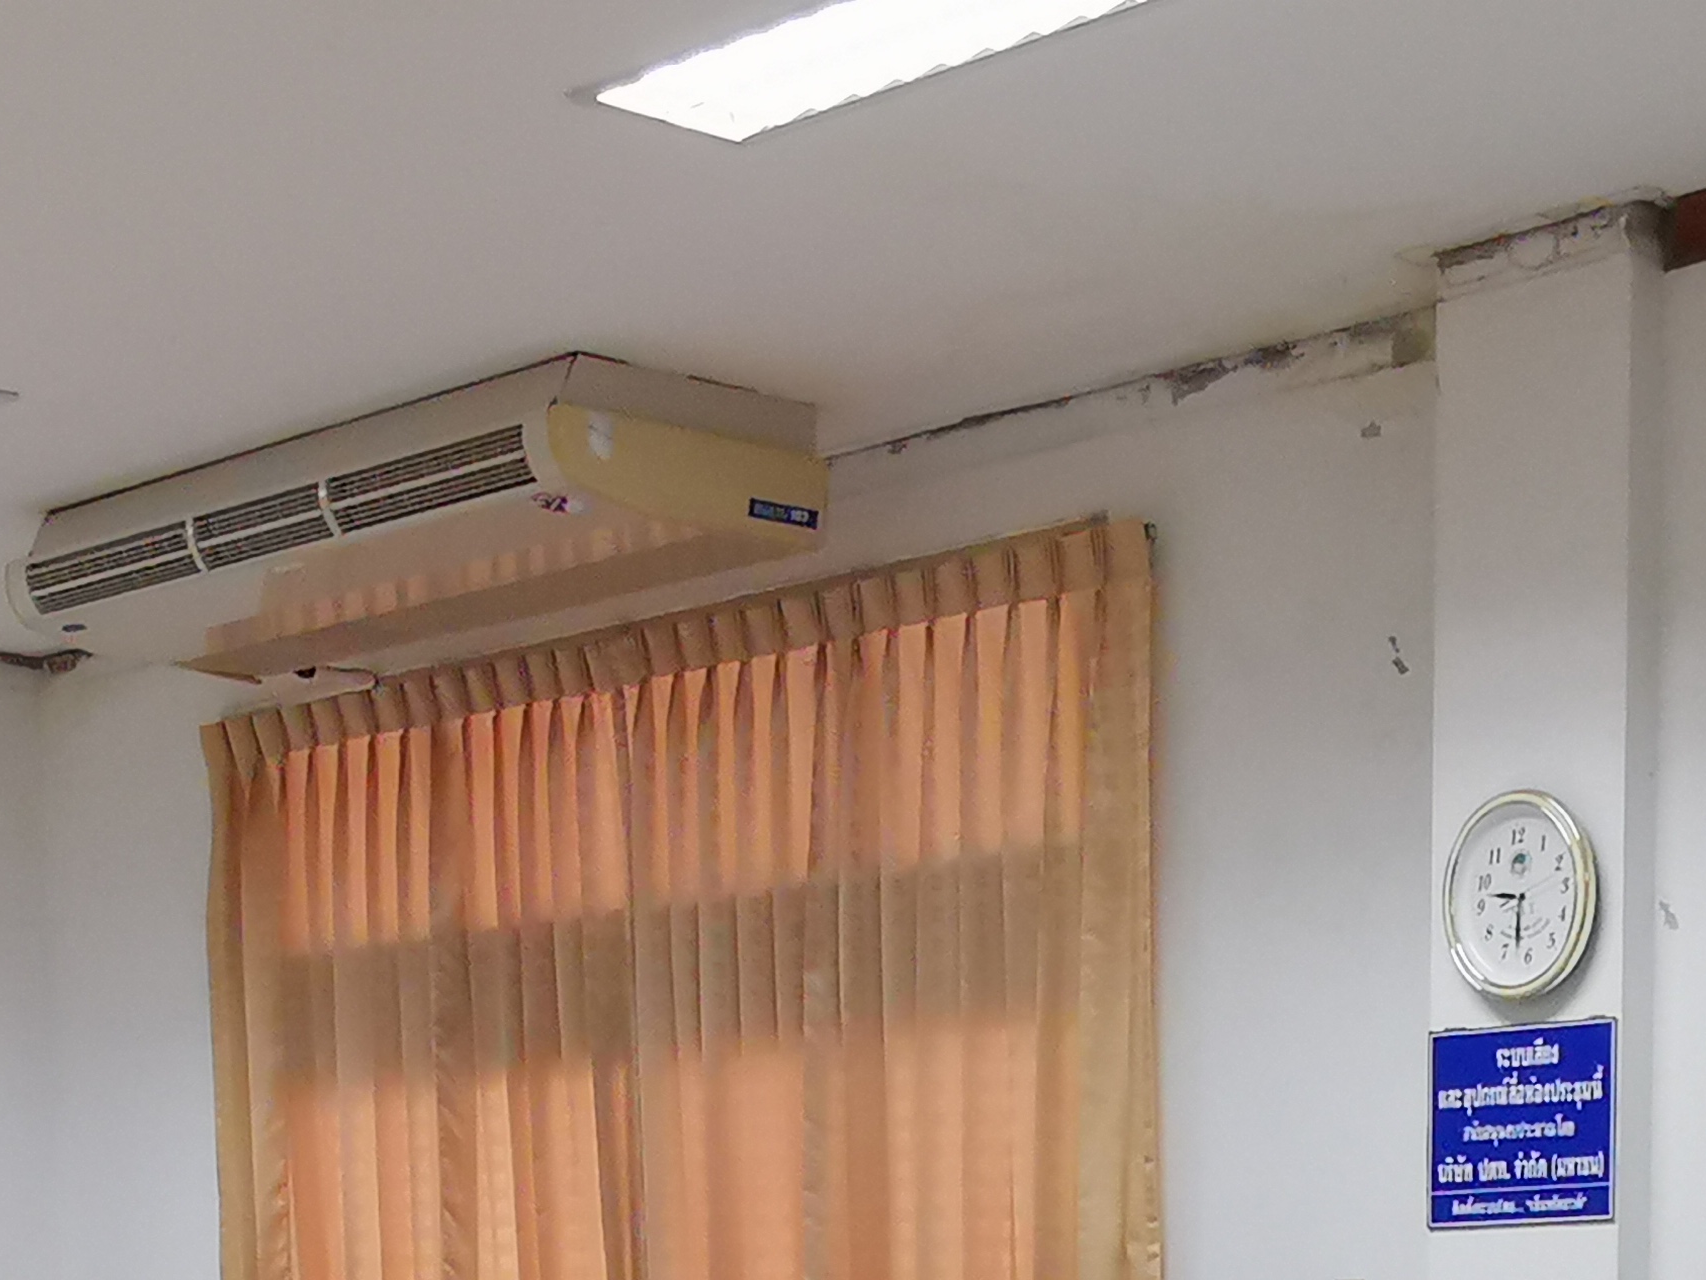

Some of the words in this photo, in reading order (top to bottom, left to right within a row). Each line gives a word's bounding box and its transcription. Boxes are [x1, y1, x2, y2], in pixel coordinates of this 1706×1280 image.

[1511, 826, 1526, 846] 12
[1488, 847, 1501, 865] 11
[1554, 853, 1565, 871] 2
[1477, 873, 1492, 892] 10
[1560, 877, 1570, 894] 3
[1476, 899, 1486, 916] 9
[1557, 905, 1566, 921] 4
[1484, 924, 1494, 941] 8
[1546, 932, 1556, 949] 5
[1500, 943, 1510, 959] 7
[1523, 947, 1533, 964] 6
[1437, 1154, 1474, 1183] บริษัท
[1513, 1150, 1548, 1180] จำกัด
[1551, 1150, 1605, 1182] (มหาชน)
